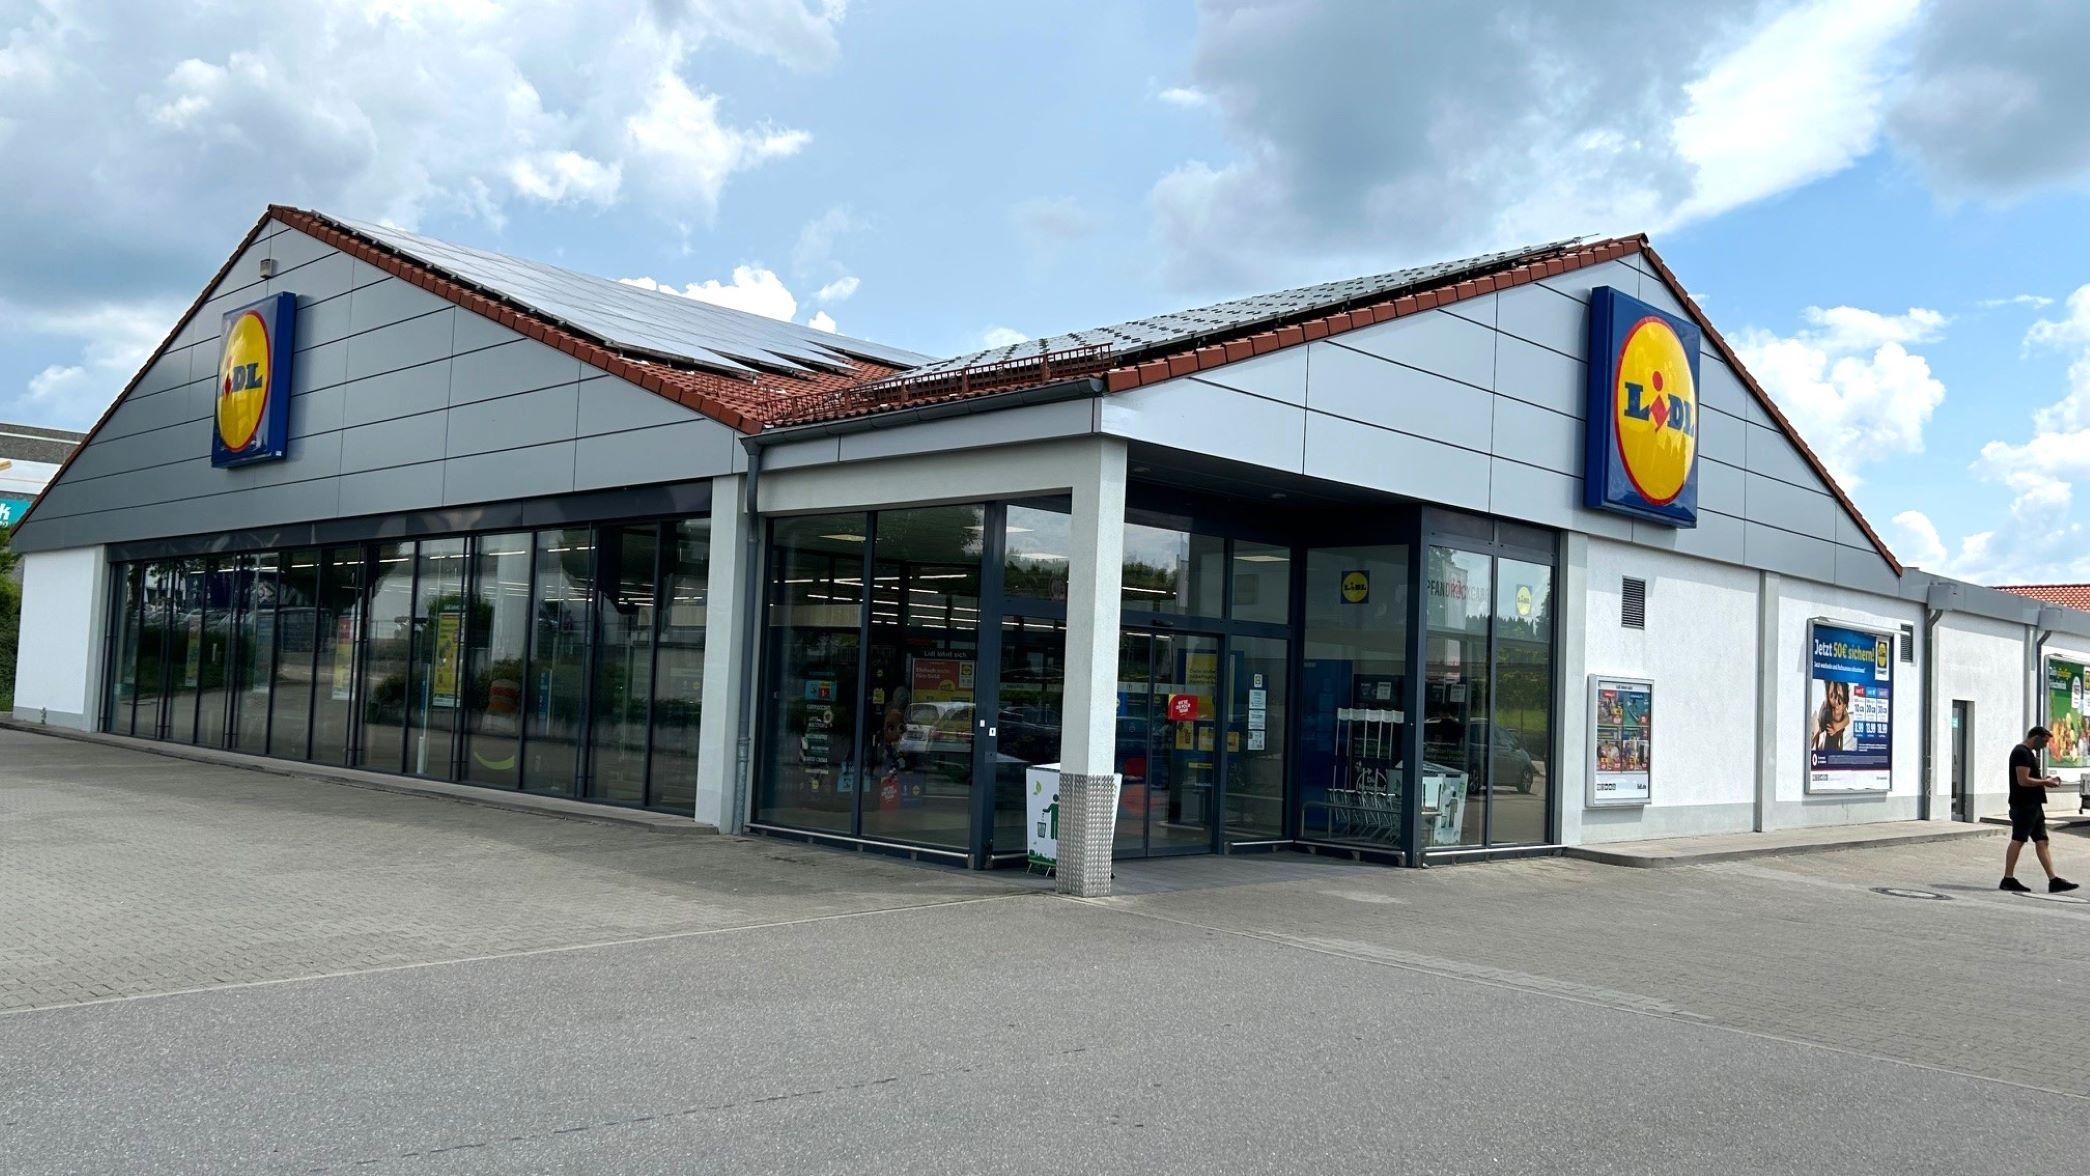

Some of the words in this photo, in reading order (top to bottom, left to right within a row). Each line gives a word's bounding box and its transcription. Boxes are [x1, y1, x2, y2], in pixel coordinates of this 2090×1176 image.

[1814, 639, 1833, 657] Jetzt
[1834, 642, 1848, 659] 50€
[1848, 645, 1875, 662] sichern!
